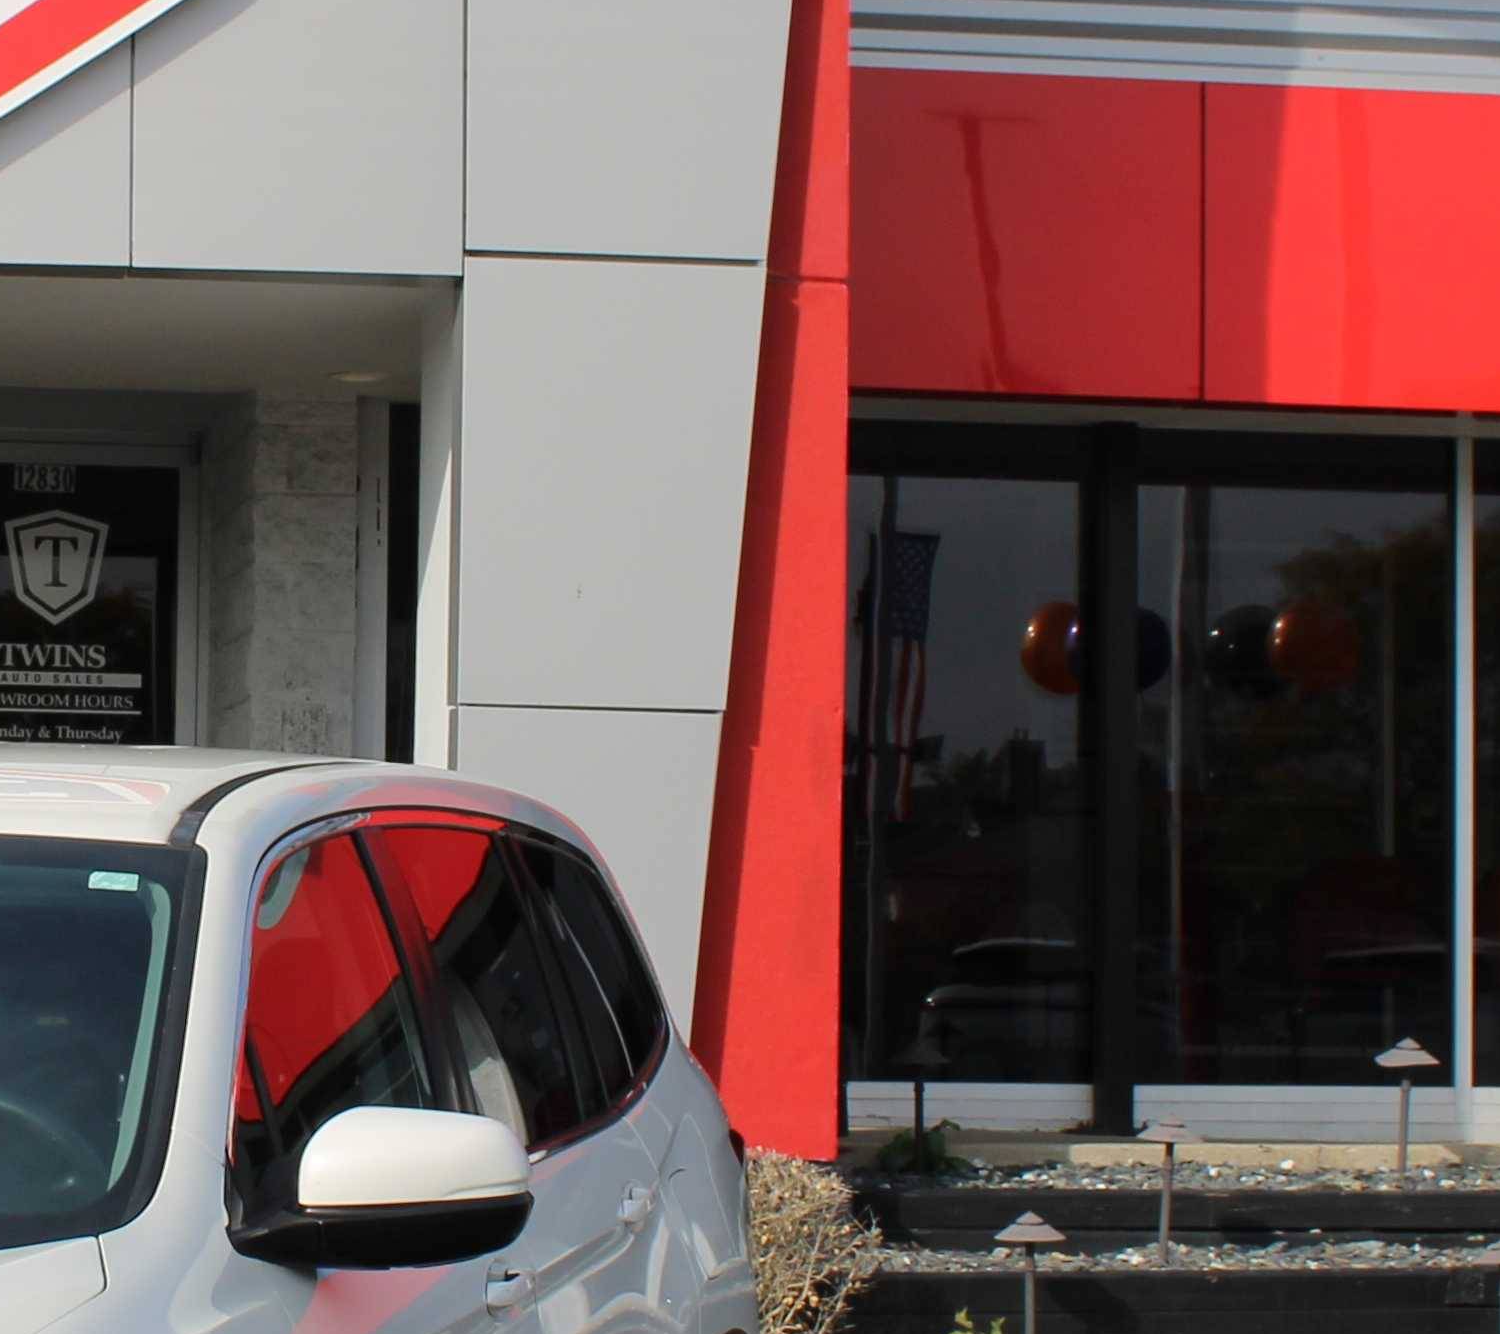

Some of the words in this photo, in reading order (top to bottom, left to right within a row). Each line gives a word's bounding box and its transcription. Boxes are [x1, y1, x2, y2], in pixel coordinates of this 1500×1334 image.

[16, 465, 75, 492] 12830
[33, 535, 79, 588] T
[0, 673, 42, 684] AUTO
[52, 673, 105, 685] SALES
[75, 694, 134, 709] HOURS
[37, 725, 50, 739] &
[55, 724, 124, 743] Thursday
